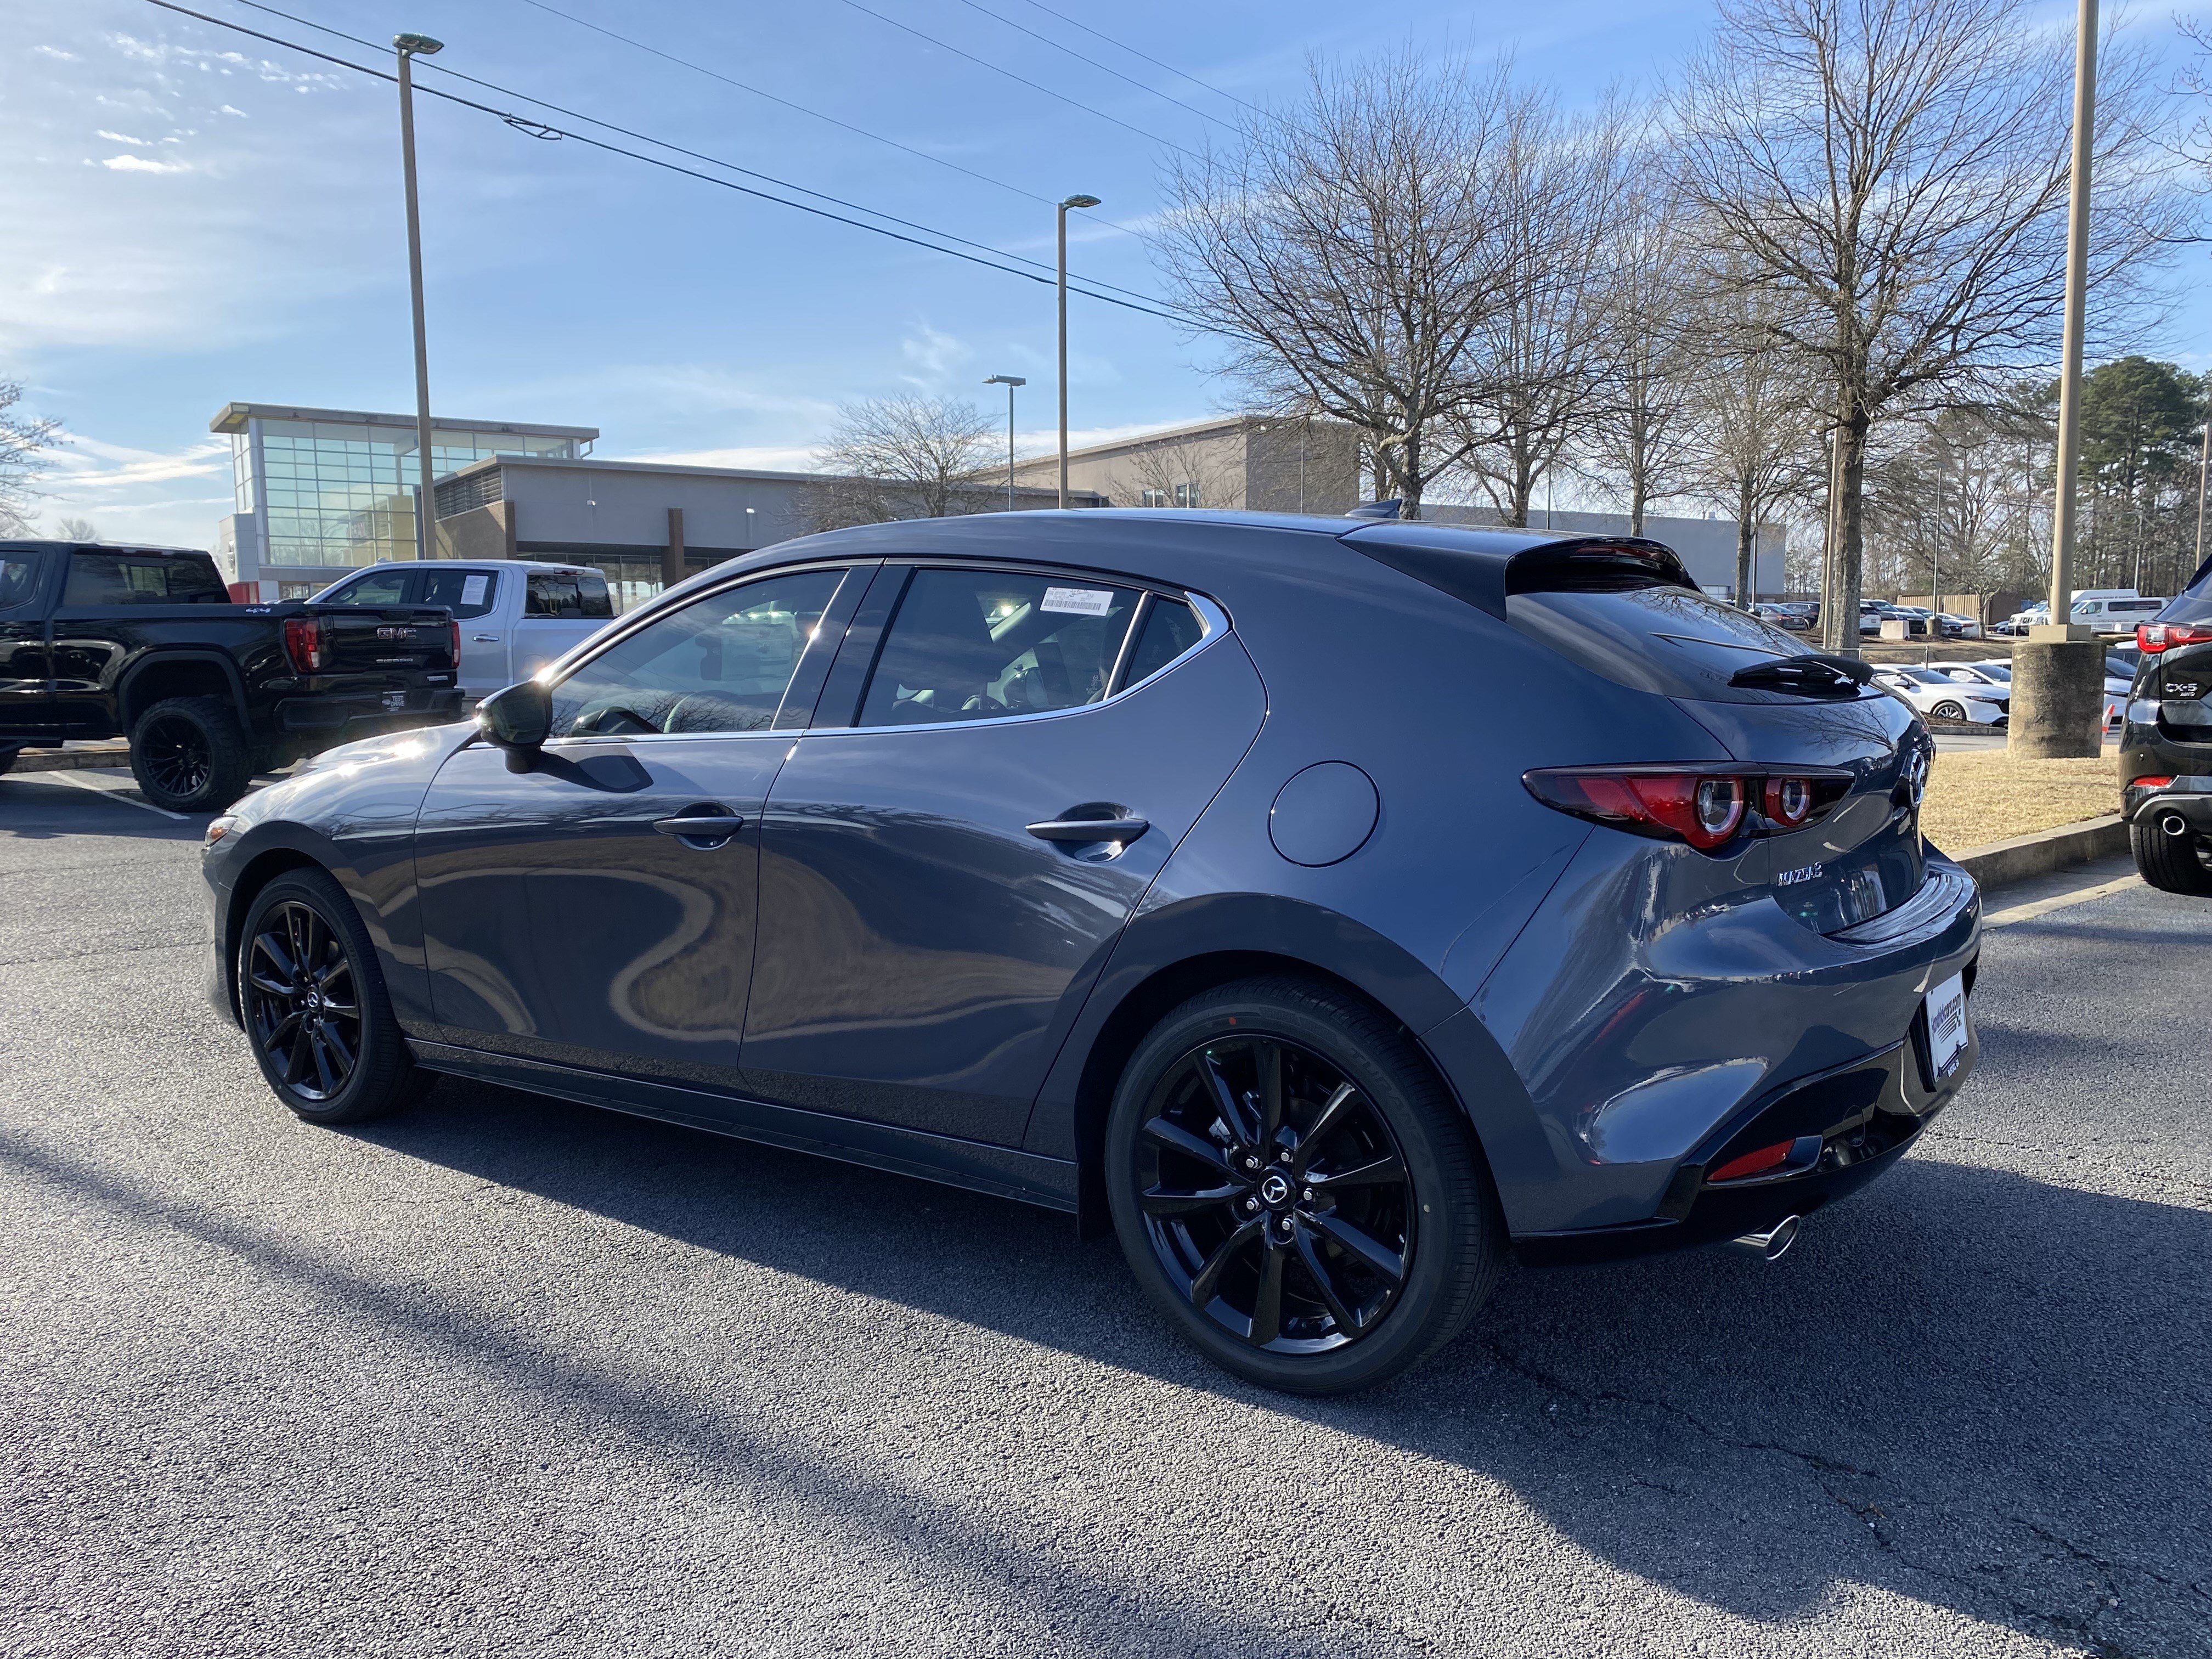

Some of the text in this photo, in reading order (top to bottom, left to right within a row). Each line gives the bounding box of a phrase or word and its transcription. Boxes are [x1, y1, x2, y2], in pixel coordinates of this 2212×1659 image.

[377, 628, 417, 639] GMC
[2165, 683, 2198, 692] CX-5
[1777, 861, 1823, 887] MAZDA3
